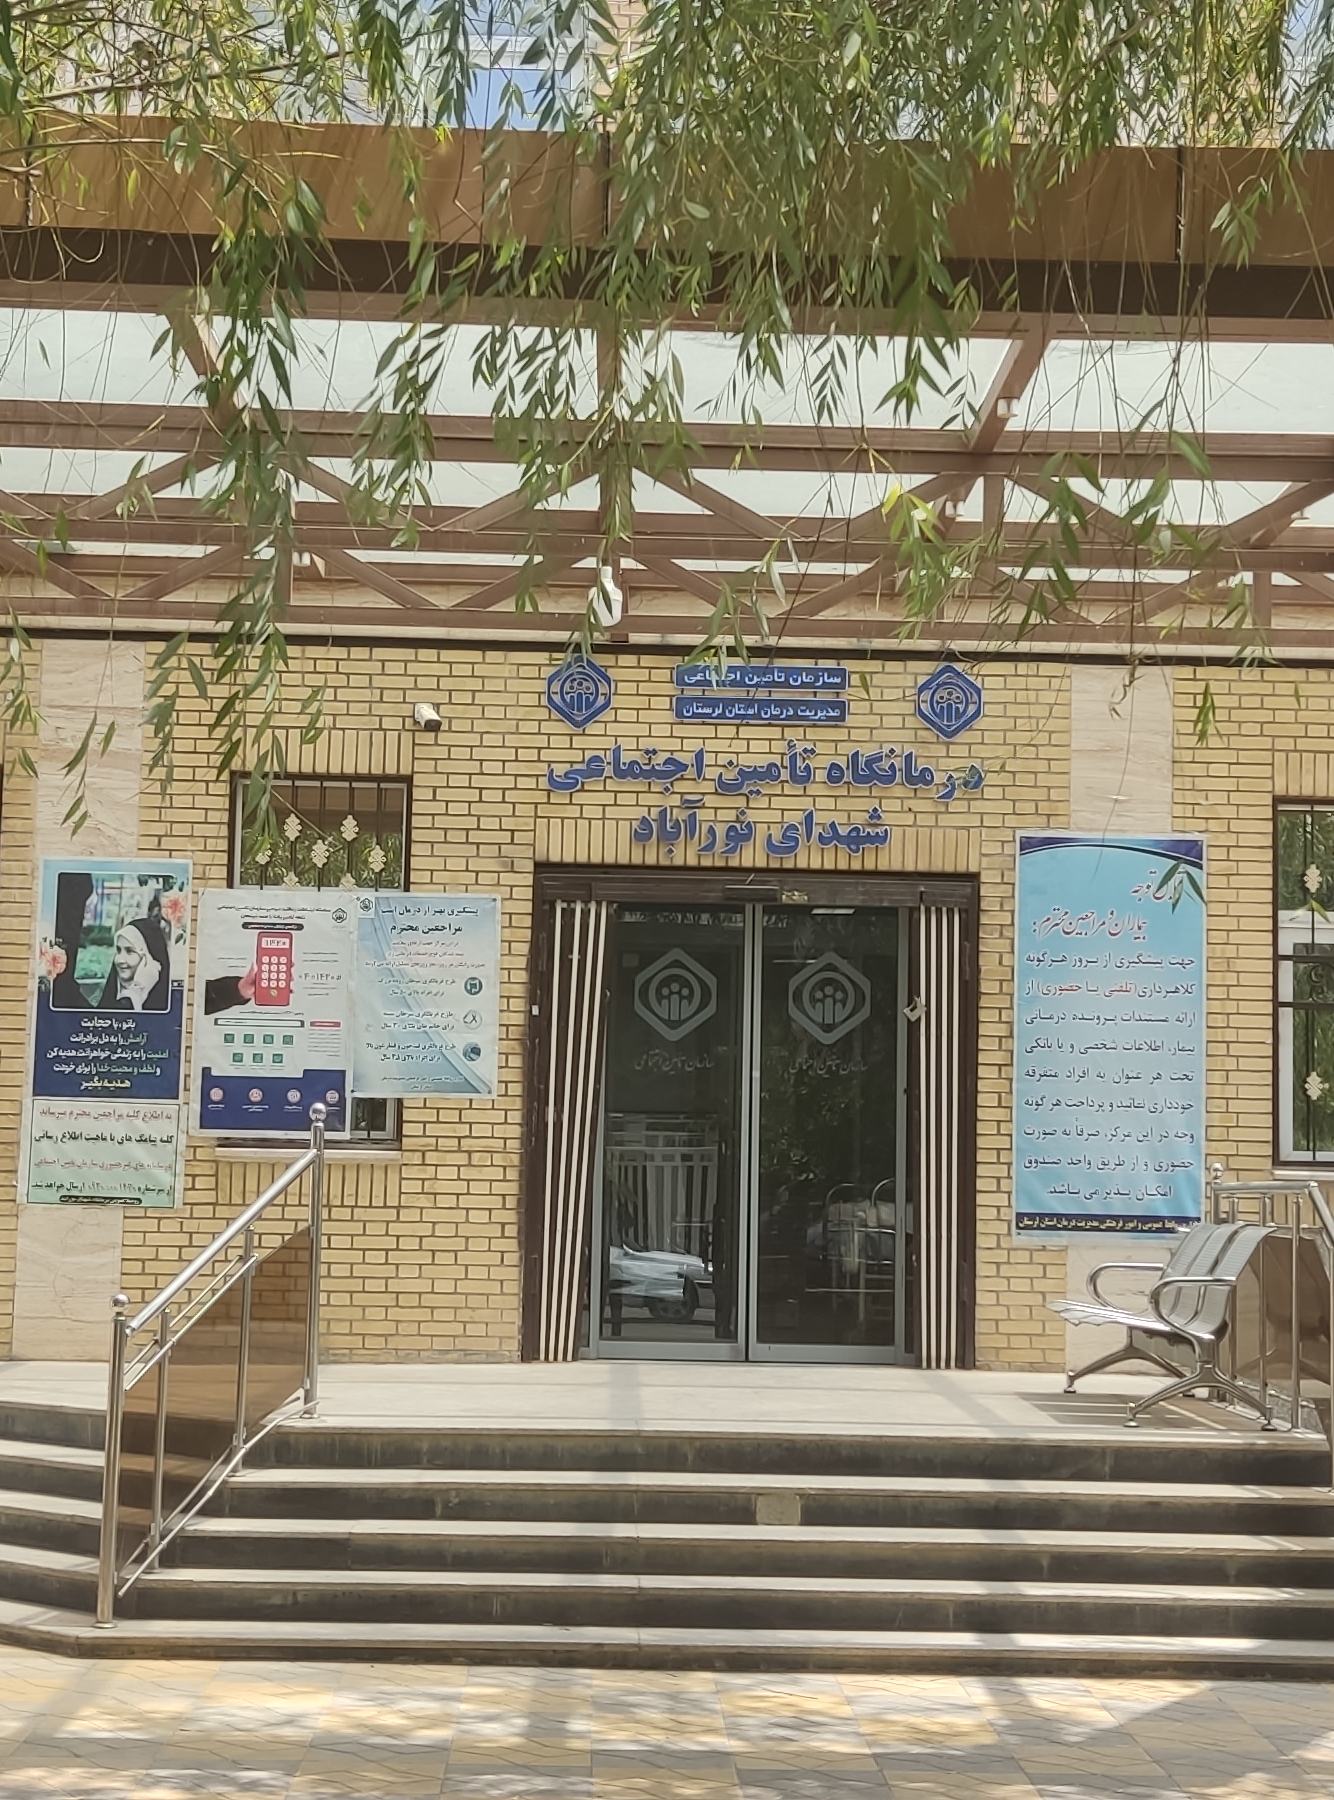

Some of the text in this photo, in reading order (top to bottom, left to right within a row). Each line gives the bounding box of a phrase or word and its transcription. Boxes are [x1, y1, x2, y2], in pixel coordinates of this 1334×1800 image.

[789, 670, 842, 686] سازمان
[683, 701, 841, 720] مدیریت درمان استان لرستان
[547, 738, 984, 800] درمانگاه تأمین اجتماعی
[632, 796, 890, 857] شهدای نورآباد
[399, 906, 421, 916] درمان
[390, 923, 463, 935] مراجعین محترم
[1071, 956, 1099, 968] بروز
[1103, 952, 1111, 968] از
[1114, 954, 1164, 969] پیشگیری
[1168, 957, 1195, 969] جهت
[1025, 980, 1034, 996] از
[1086, 981, 1099, 995] یا
[80, 1016, 111, 1030] حجابت
[1025, 1009, 1196, 1028] ارائه مستندات پرونده درمانی
[1024, 1037, 1053, 1054] بانکی
[1057, 1038, 1064, 1053] یا
[1069, 1044, 1075, 1054] و
[1079, 1039, 1117, 1055] شخصی
[1123, 1040, 1164, 1052] اطلاعات
[1024, 1065, 1195, 1085] تحت هر عنوان به افراد متفرقه
[1064, 1096, 1105, 1113] پرداخت
[1108, 1101, 1114, 1112] و
[1148, 1098, 1195, 1115] خودداری
[60, 1131, 83, 1144] اطلاع
[1023, 1126, 1057, 1141] صورت
[1061, 1128, 1072, 1140] به
[1137, 1127, 1153, 1142] این
[1157, 1130, 1169, 1143] در
[1174, 1131, 1195, 1143] وجه
[1023, 1154, 1194, 1173] حضوری و از طریق واحد صندوق
[1083, 1188, 1100, 1200] می
[1102, 1183, 1131, 1200] پذیر
[1135, 1185, 1172, 1201] امکان
